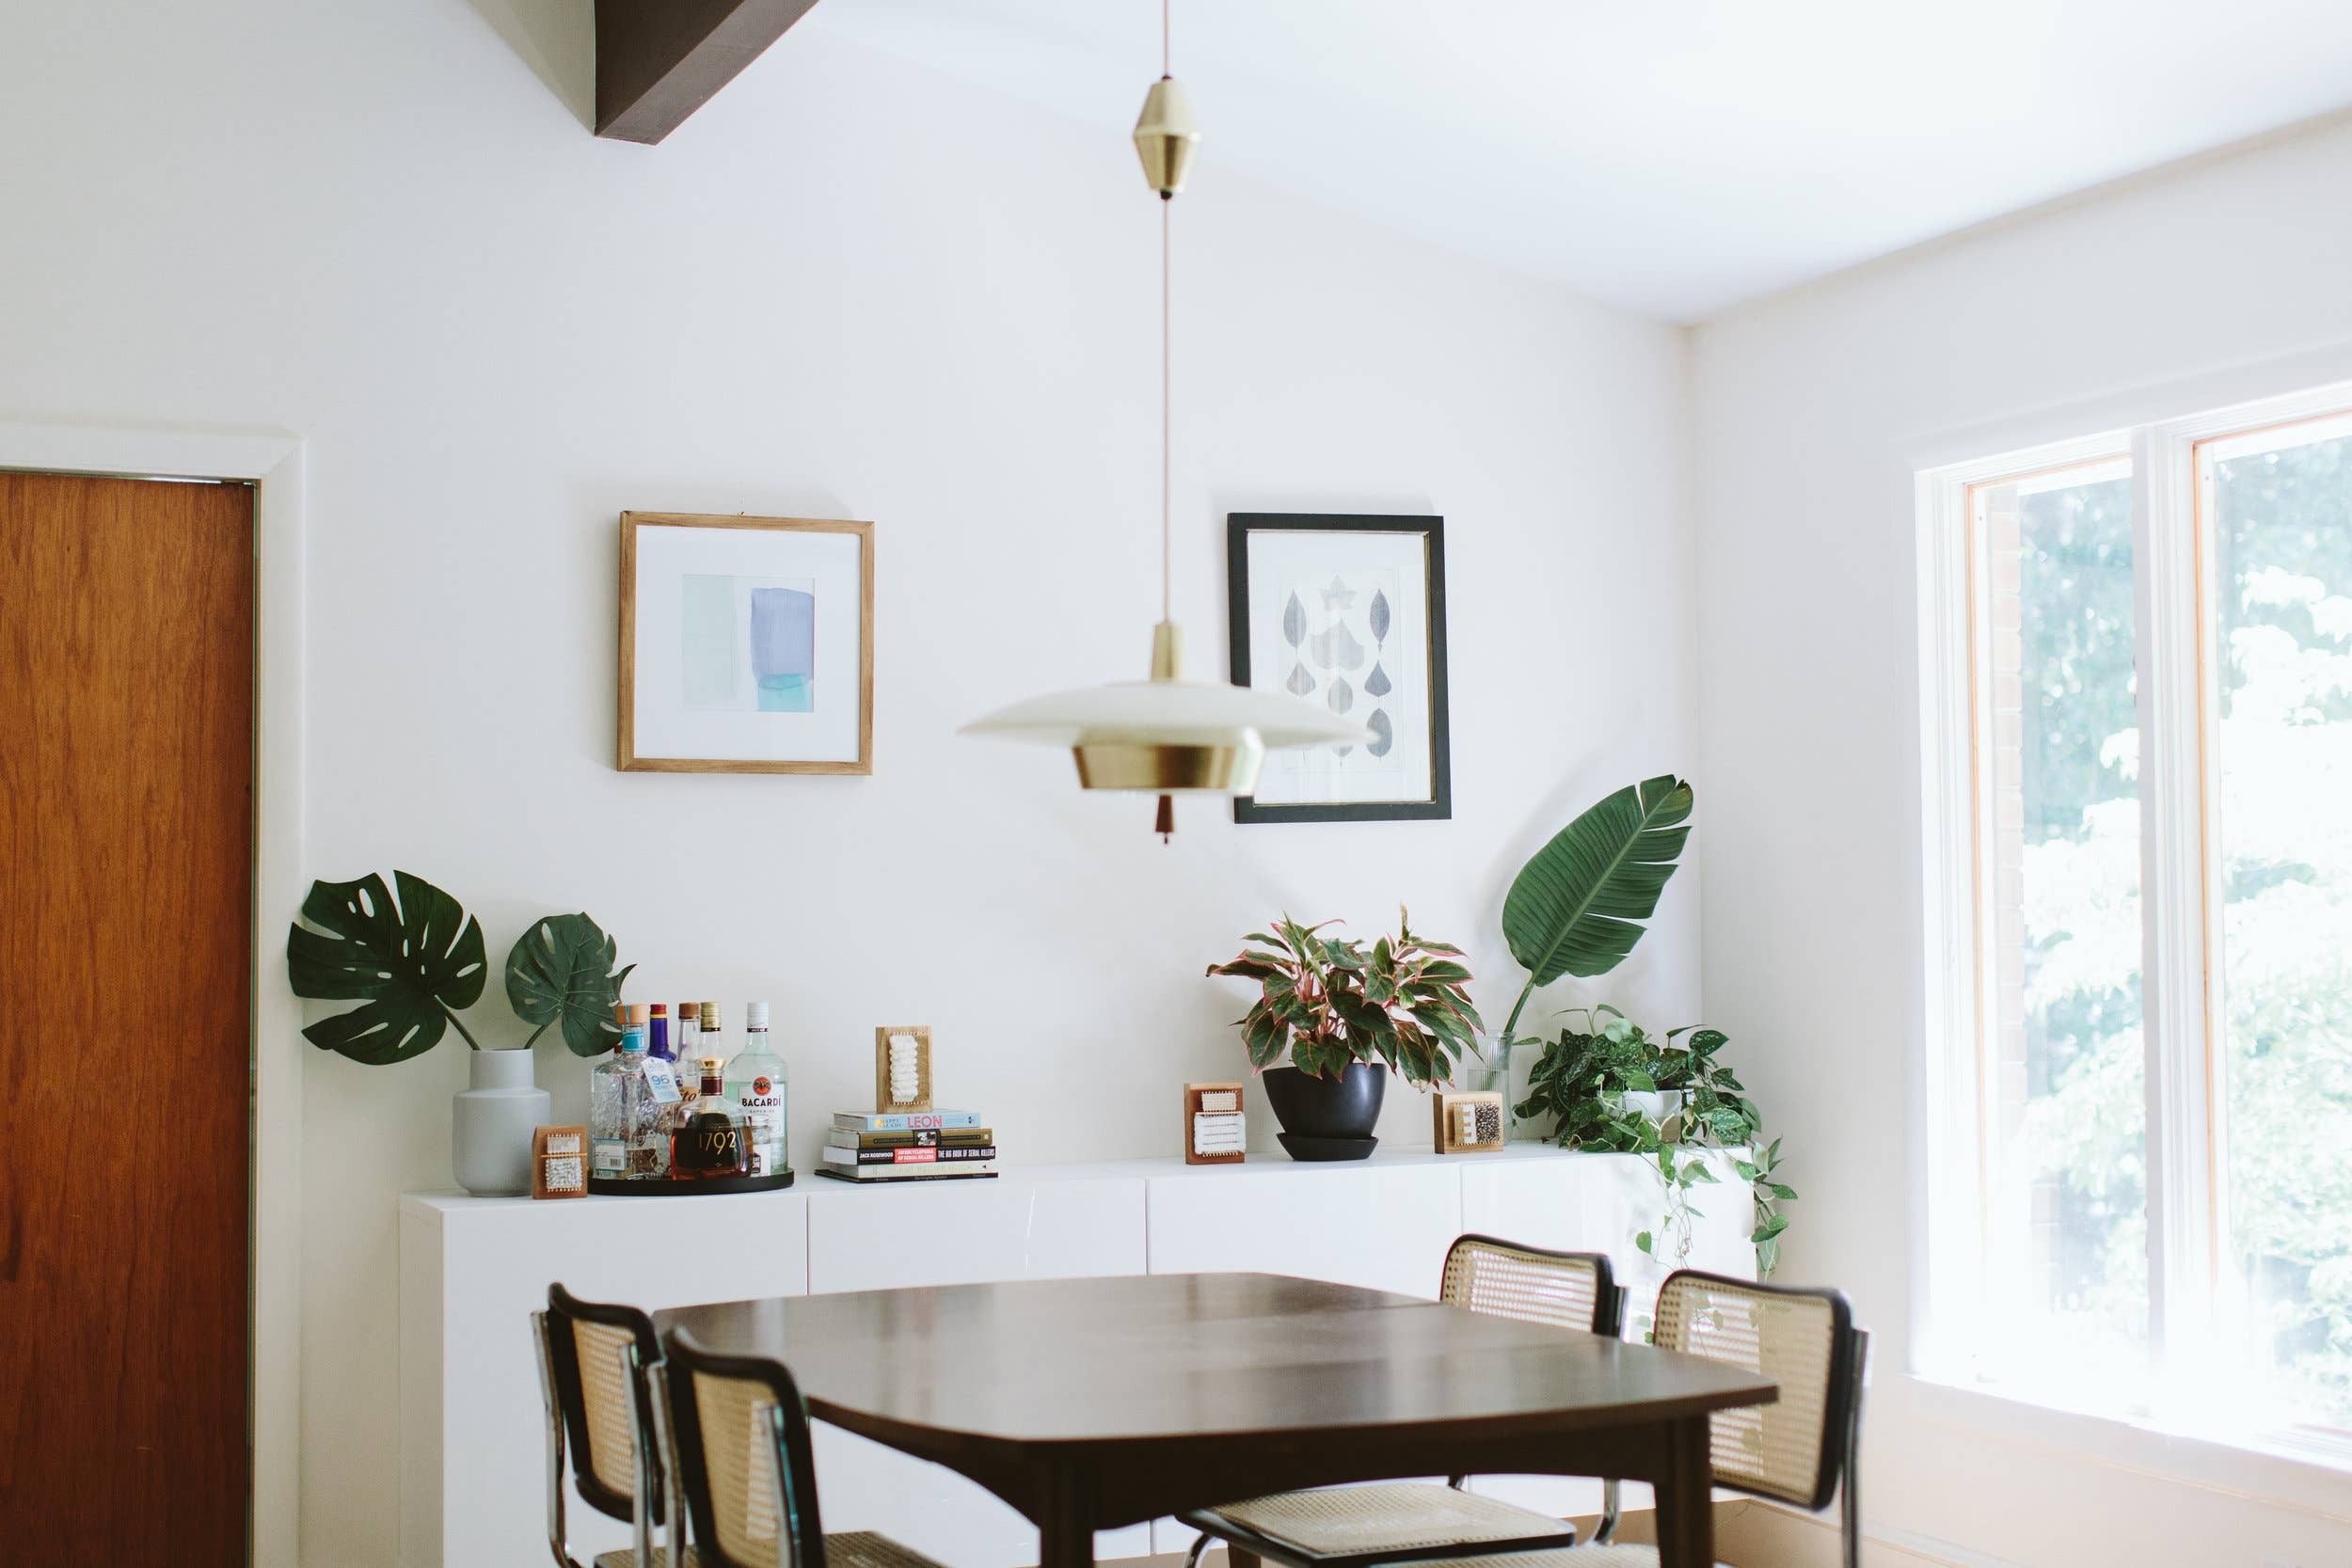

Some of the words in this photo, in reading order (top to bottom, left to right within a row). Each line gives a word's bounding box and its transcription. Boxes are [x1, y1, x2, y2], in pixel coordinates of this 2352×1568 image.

[651, 1074, 670, 1085] 96
[741, 1096, 782, 1107] BACARDÍ
[907, 1117, 943, 1128] LEON
[699, 1131, 737, 1155] 1792
[937, 1150, 946, 1159] THE
[952, 1149, 962, 1158] BOOK
